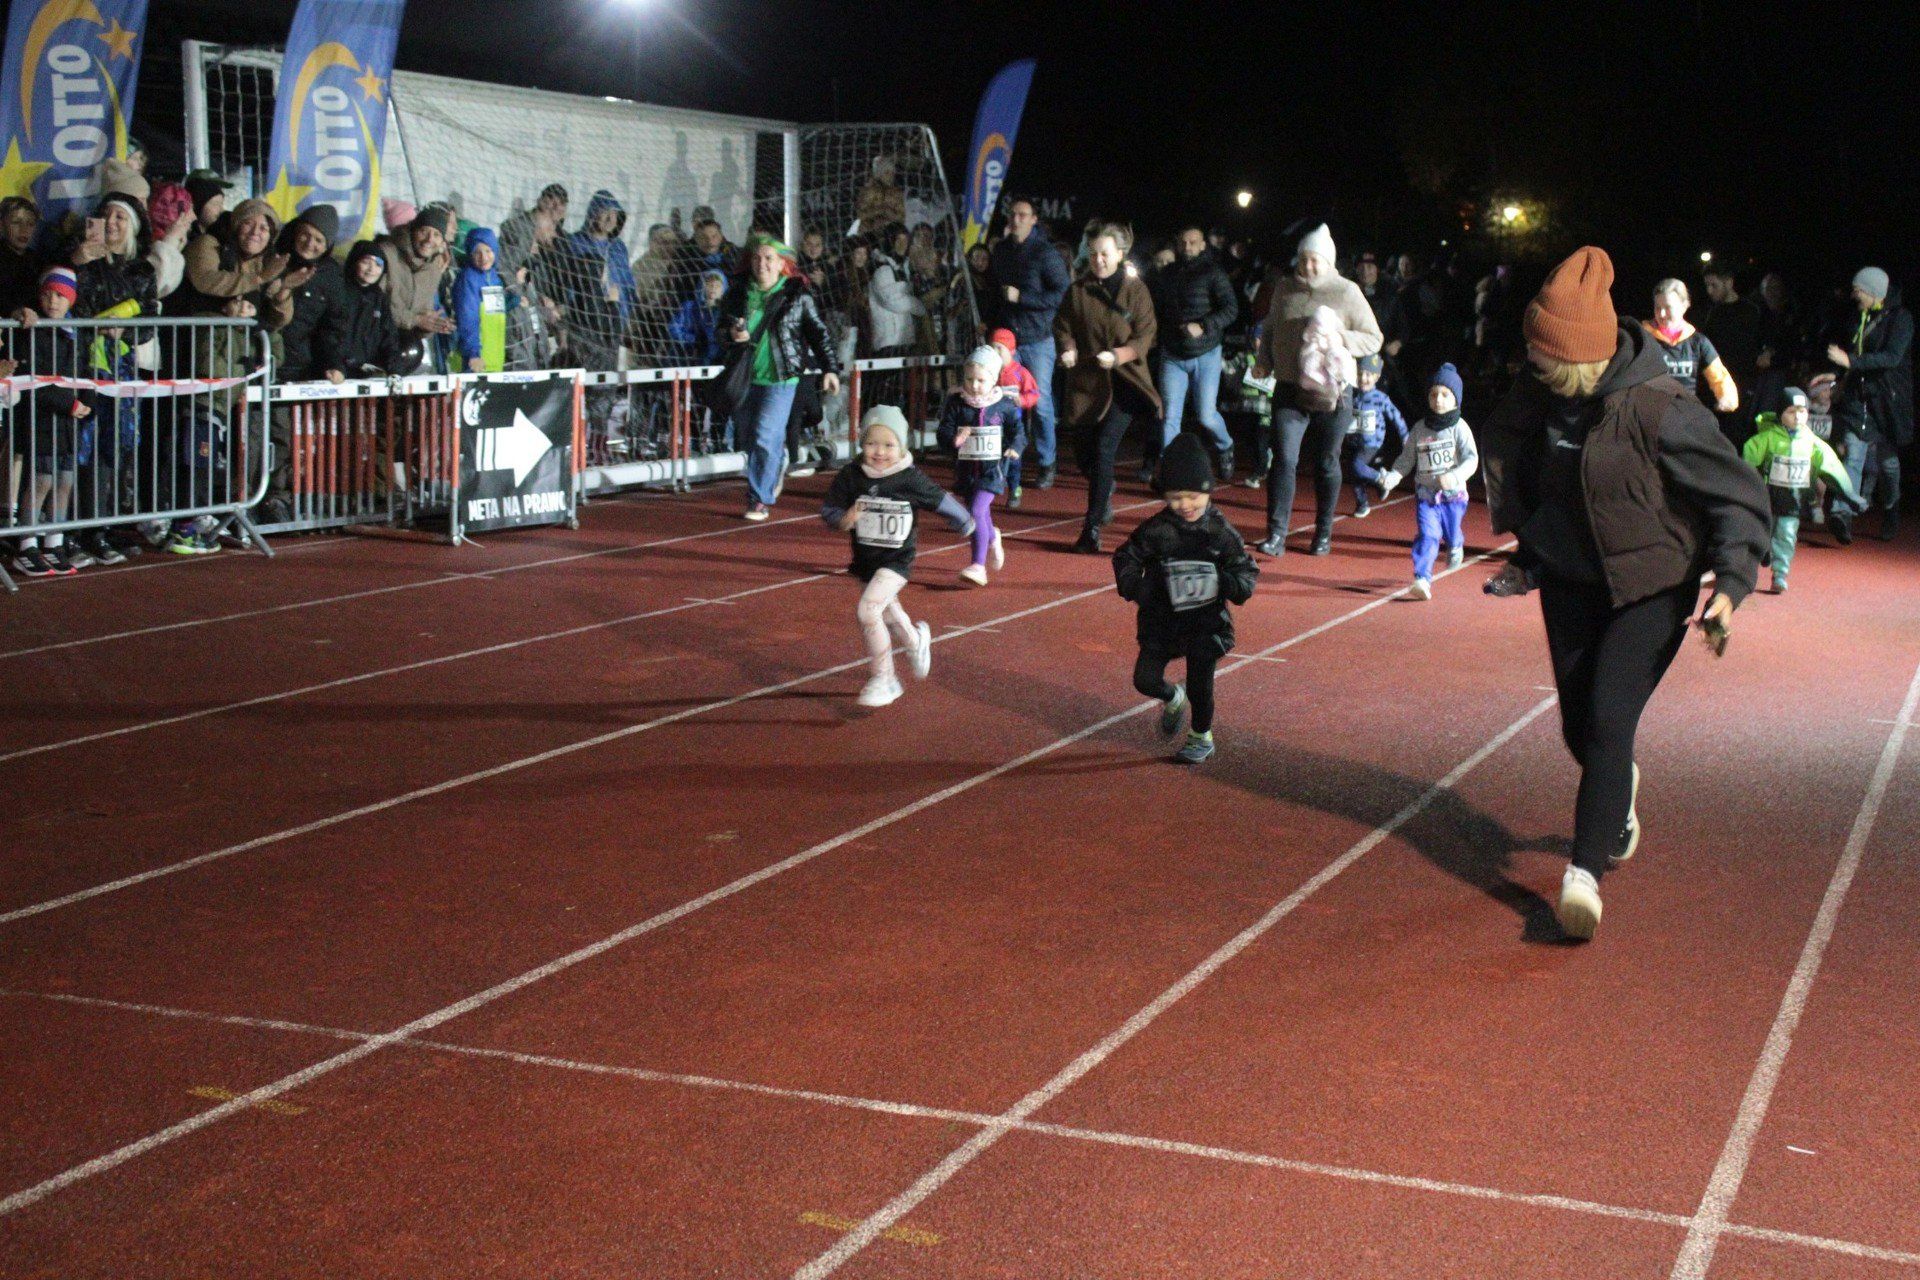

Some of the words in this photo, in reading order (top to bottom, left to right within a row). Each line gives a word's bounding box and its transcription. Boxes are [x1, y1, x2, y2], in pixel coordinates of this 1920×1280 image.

[47, 44, 108, 199] LOTTO
[312, 86, 363, 218] LOTTO
[975, 436, 994, 452] 116
[1427, 449, 1454, 467] 108
[468, 498, 500, 521] META
[502, 496, 521, 517] NA
[879, 515, 905, 536] 101
